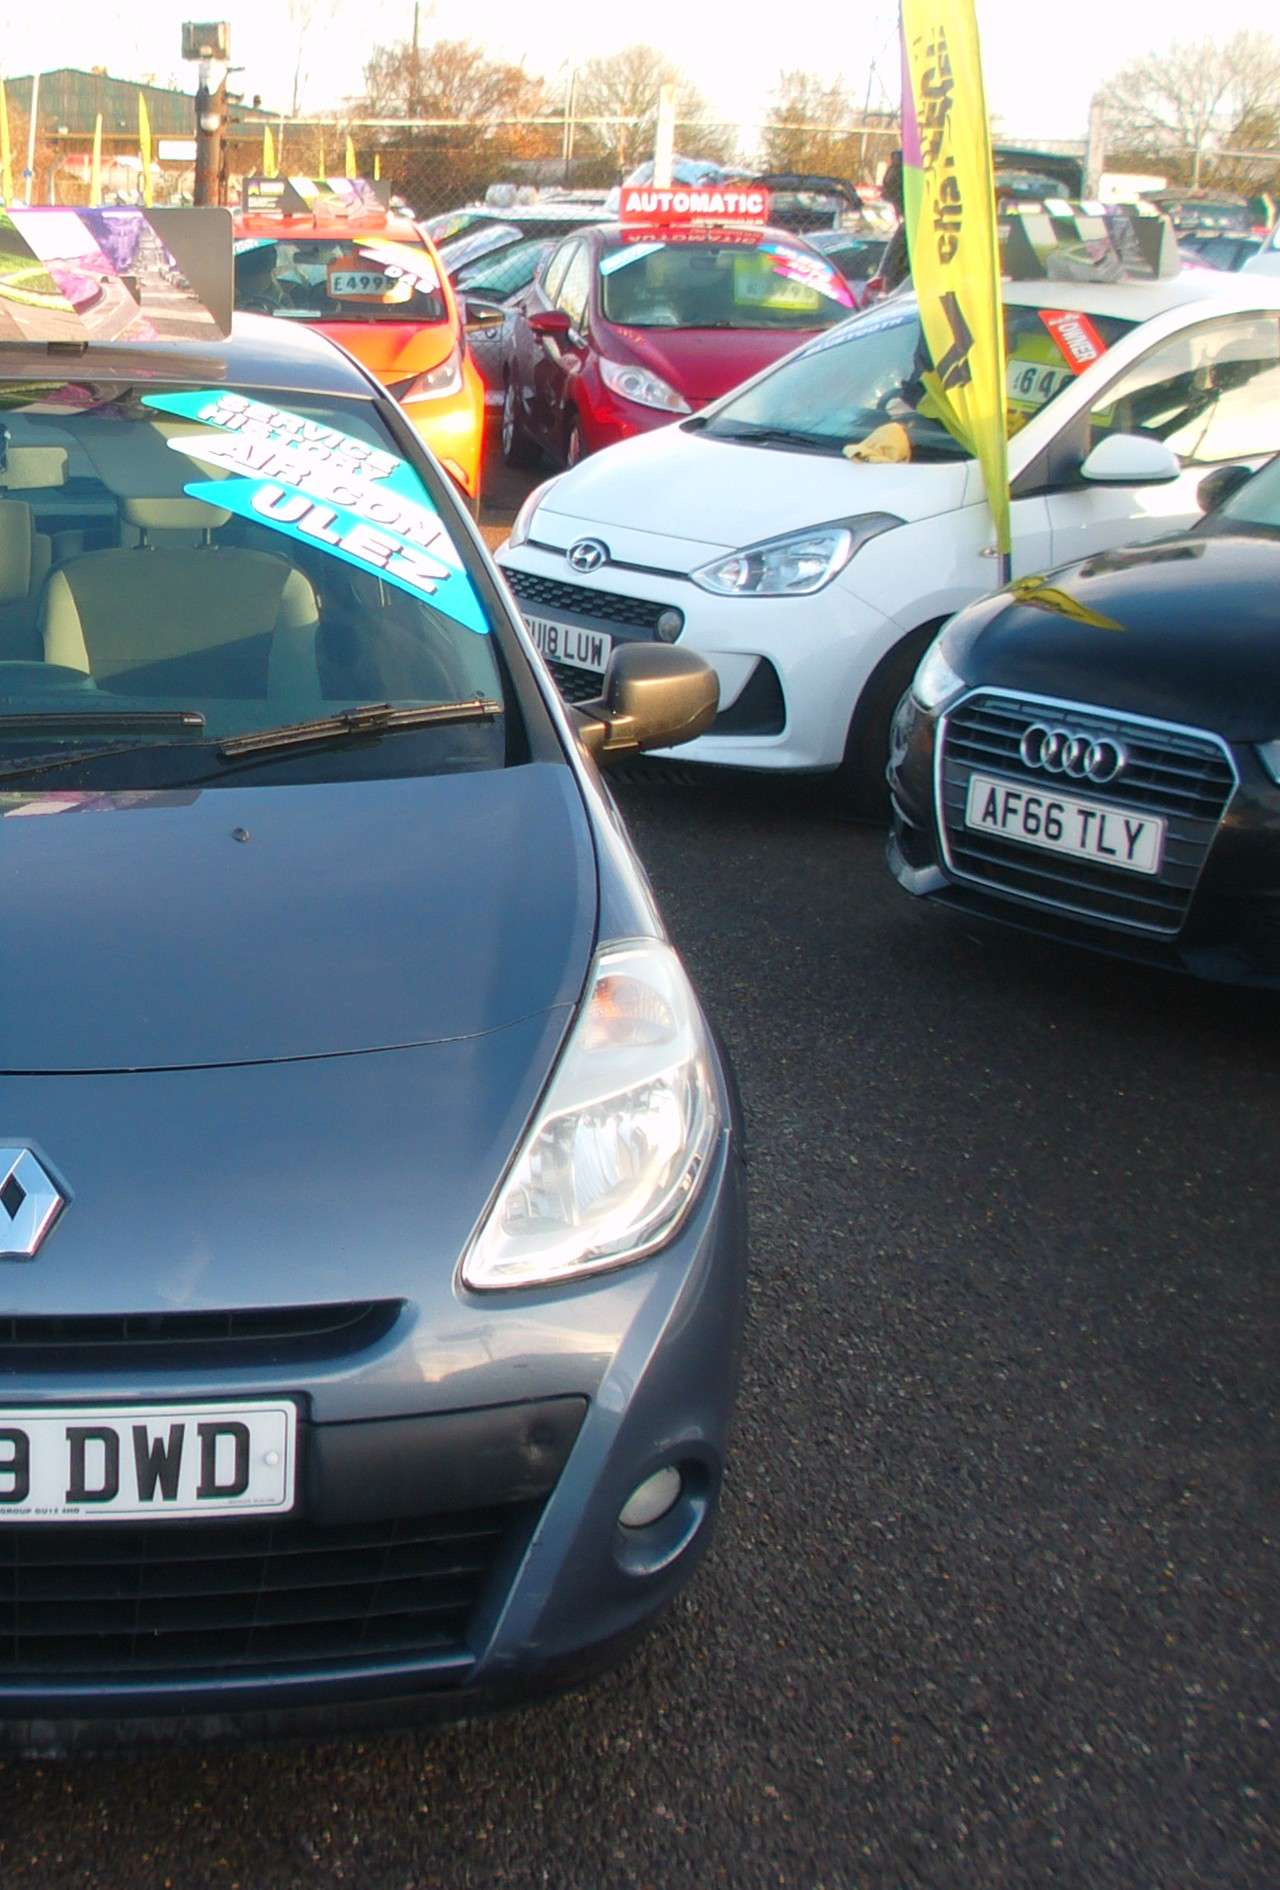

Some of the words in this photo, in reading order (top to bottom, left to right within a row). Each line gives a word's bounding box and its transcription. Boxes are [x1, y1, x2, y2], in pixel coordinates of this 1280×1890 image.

[625, 191, 764, 214] AUTOMATIC
[218, 394, 400, 474] SERVICE
[250, 485, 450, 595] ULEZ
[525, 621, 558, 655] U18
[564, 625, 604, 668] LUW
[982, 787, 1064, 841] AF66
[1077, 809, 1145, 860] TLY
[65, 1420, 251, 1503] DWD
